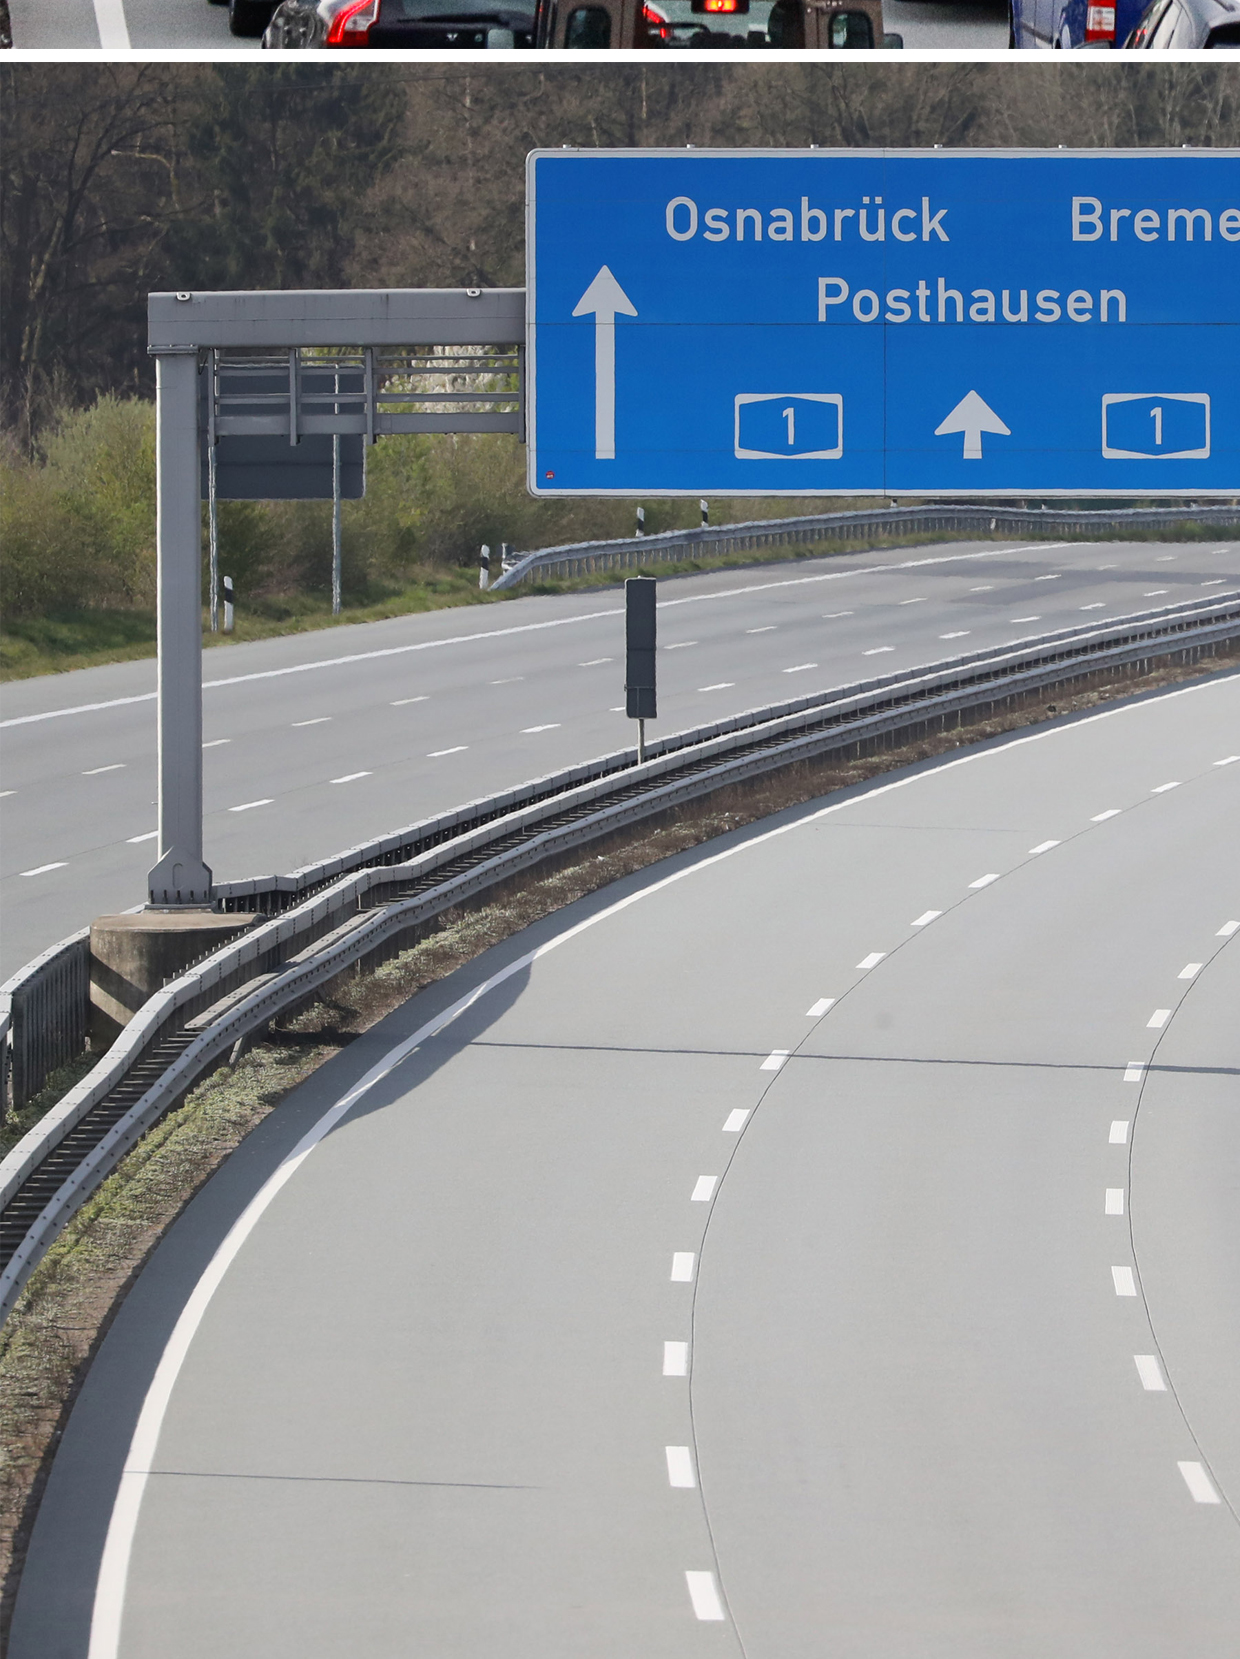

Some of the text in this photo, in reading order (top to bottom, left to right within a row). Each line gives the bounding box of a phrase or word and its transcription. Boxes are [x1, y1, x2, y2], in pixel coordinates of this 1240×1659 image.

[665, 196, 950, 242] Osnabrück
[818, 276, 1127, 323] Posthausen
[782, 407, 795, 445] 1
[1150, 406, 1163, 445] 1
